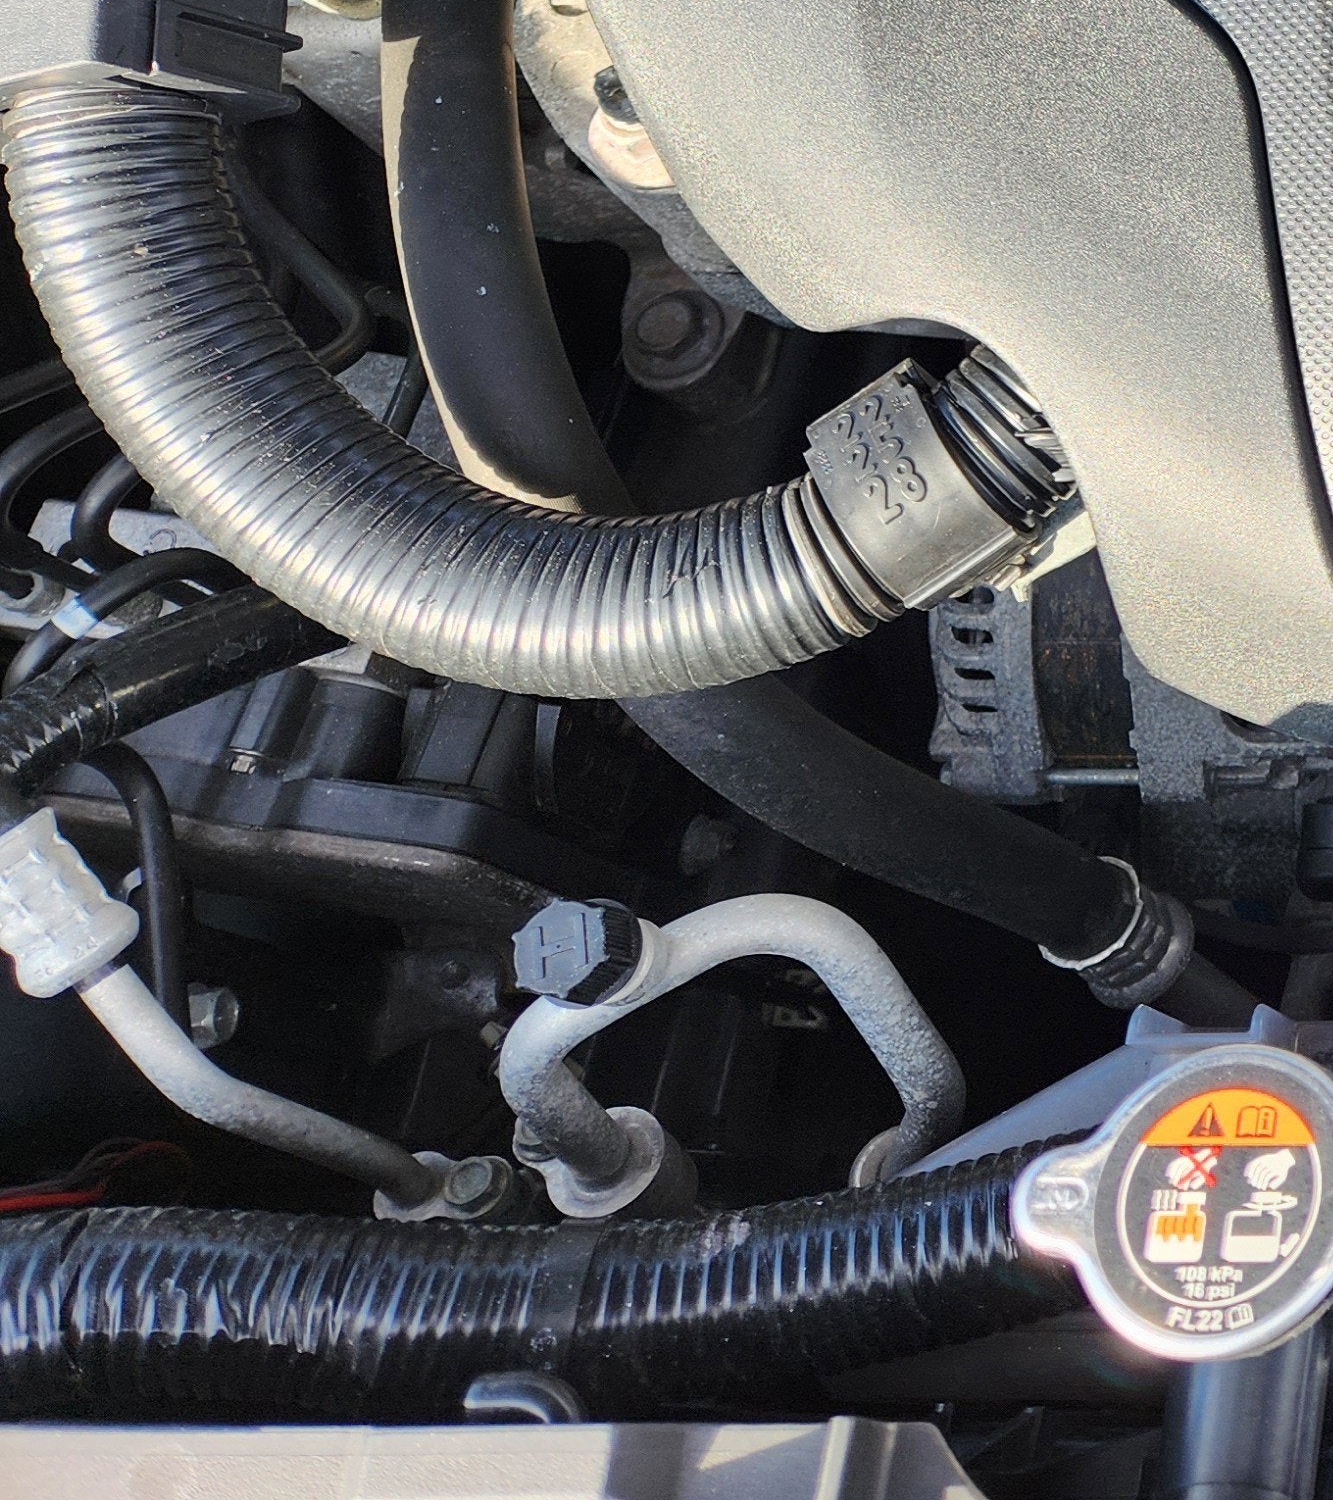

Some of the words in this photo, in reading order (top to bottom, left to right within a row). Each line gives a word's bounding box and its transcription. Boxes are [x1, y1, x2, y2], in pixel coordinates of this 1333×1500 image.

[864, 455, 928, 525] 28
[1209, 1266, 1243, 1284] kPa
[1206, 1283, 1236, 1302] psi
[1166, 1306, 1224, 1333] FL22
